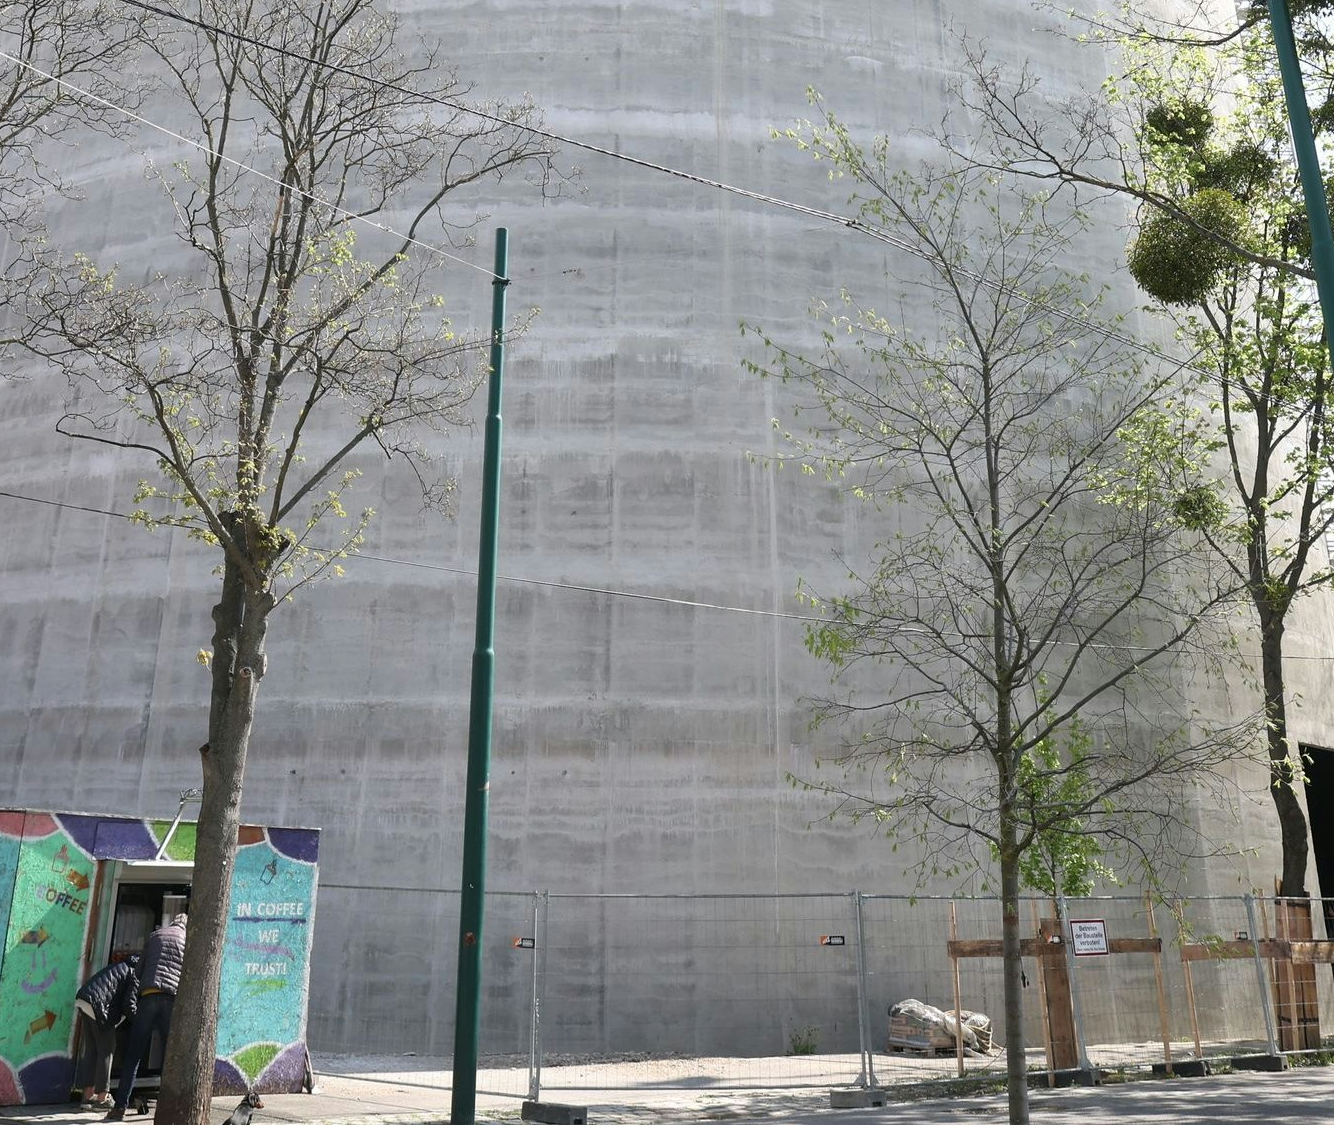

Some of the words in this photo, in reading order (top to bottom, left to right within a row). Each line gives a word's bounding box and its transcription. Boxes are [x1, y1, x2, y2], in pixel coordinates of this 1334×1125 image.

[36, 883, 88, 916] COFFEE
[236, 902, 252, 917] IN
[257, 902, 304, 916] COFFEE
[258, 929, 280, 943] WE
[245, 962, 287, 976] TRUST!
